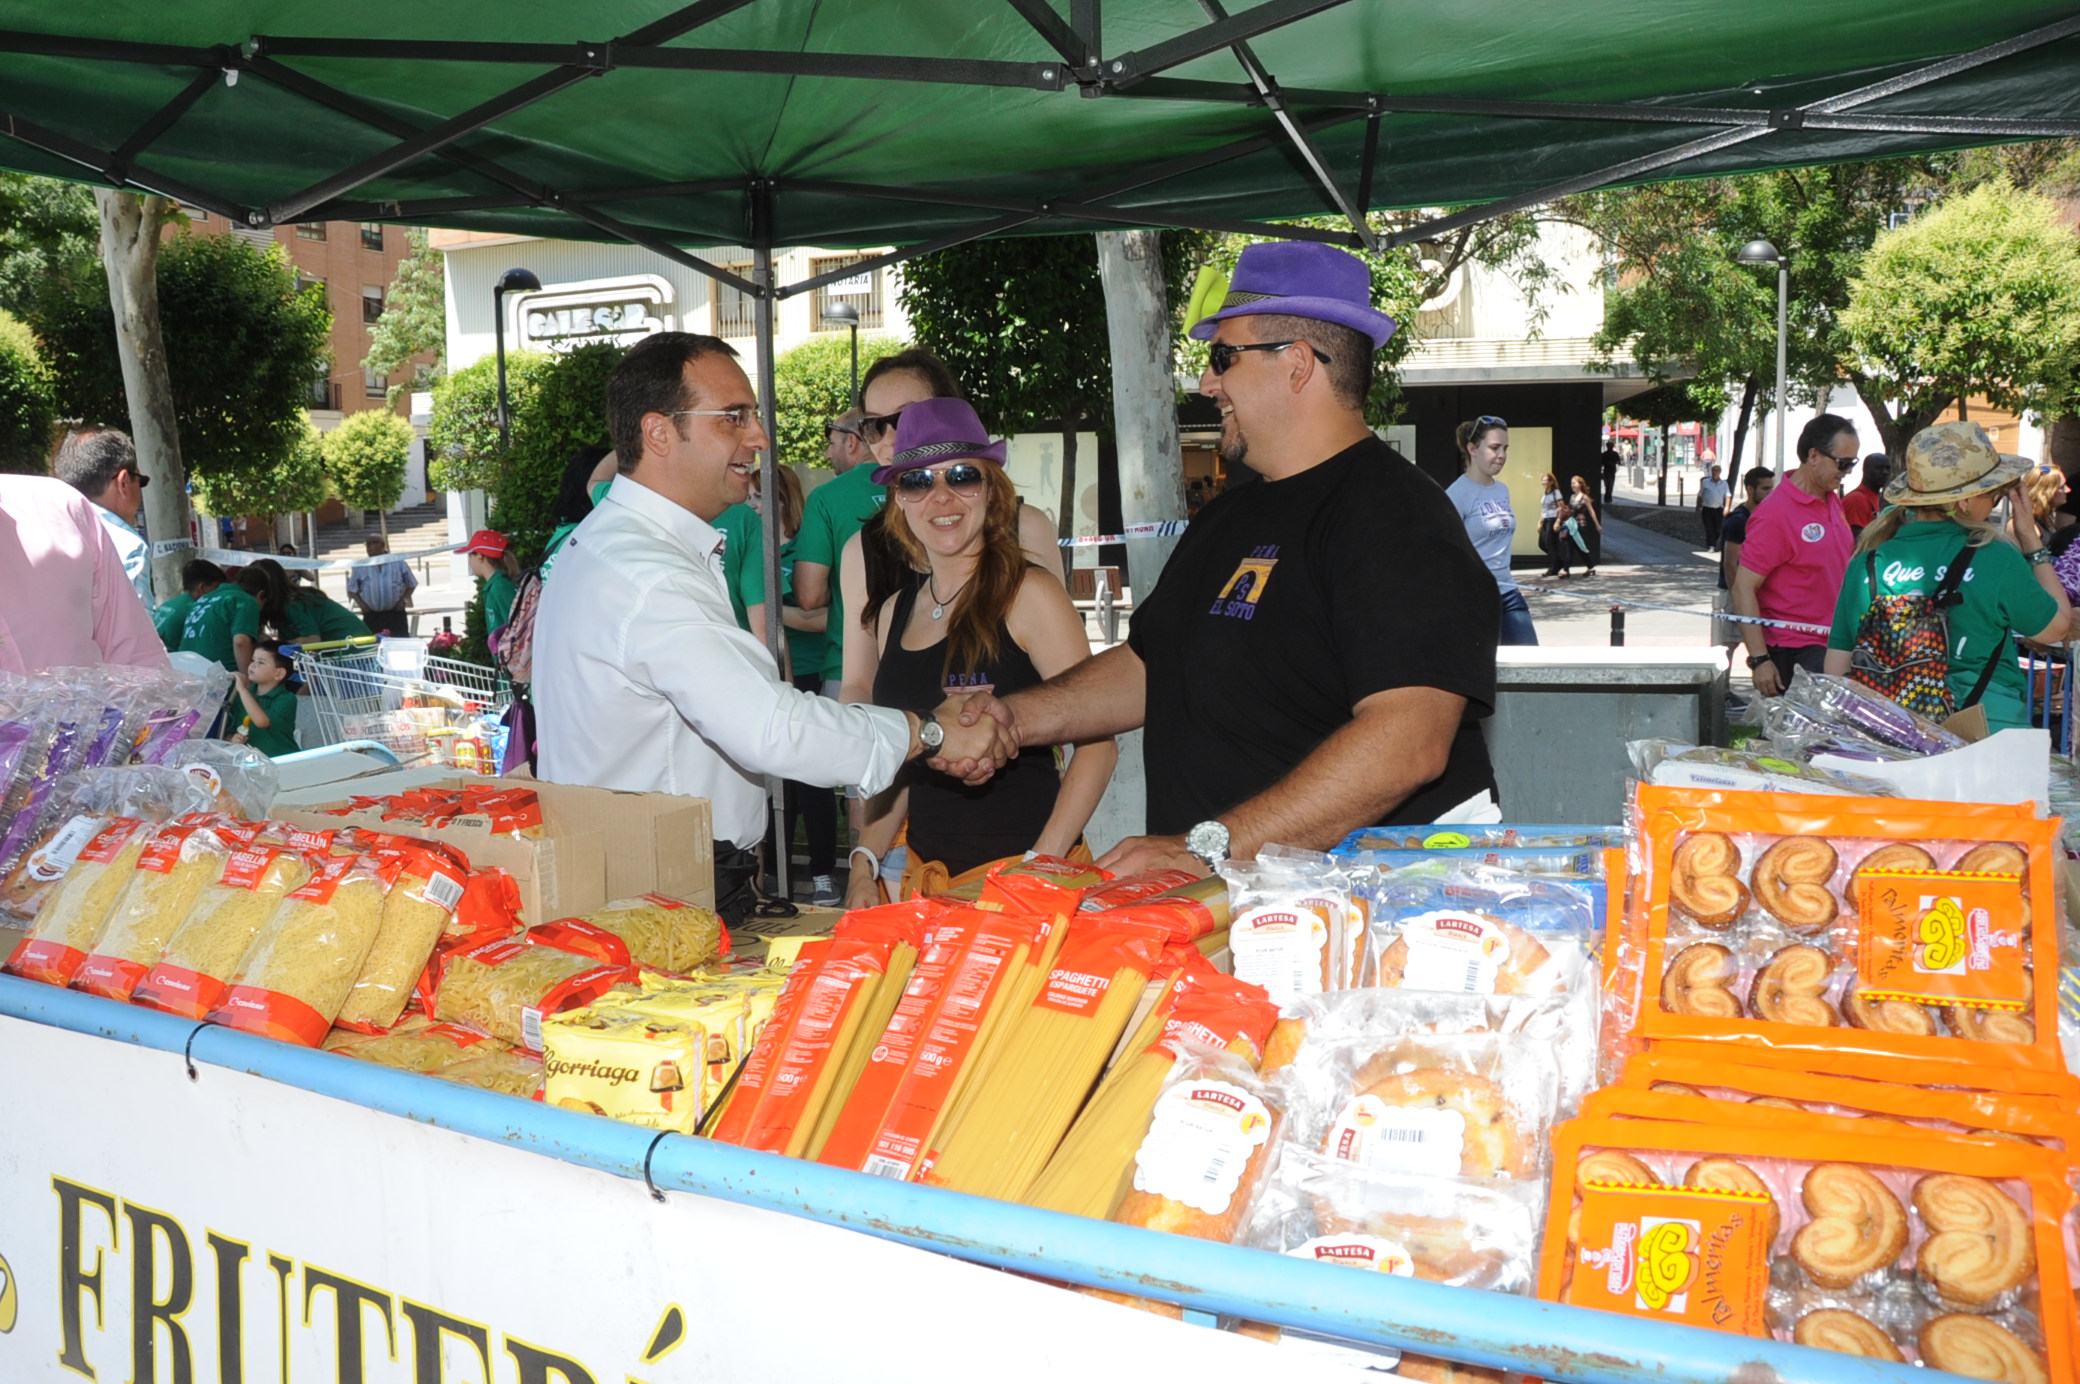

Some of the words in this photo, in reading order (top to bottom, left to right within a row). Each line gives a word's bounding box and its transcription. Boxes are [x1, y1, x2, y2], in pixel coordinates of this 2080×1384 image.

[1882, 560, 1925, 587] Que
[1208, 600, 1224, 615] EL
[1224, 601, 1256, 621] SOTO
[231, 851, 270, 867] CABELLÍN
[1256, 914, 1295, 926] LARTESA
[1440, 920, 1480, 934] LARTESA
[1877, 887, 1910, 980] Palmeritas
[1049, 969, 1111, 990] SPAGHETTI
[1049, 980, 1098, 997] ESPARGUETE
[1196, 1091, 1242, 1109] LARTESA
[1319, 1246, 1371, 1258] LARTESA
[50, 1172, 688, 1384] FRUT
[1699, 1212, 1744, 1326] Palmeritas
